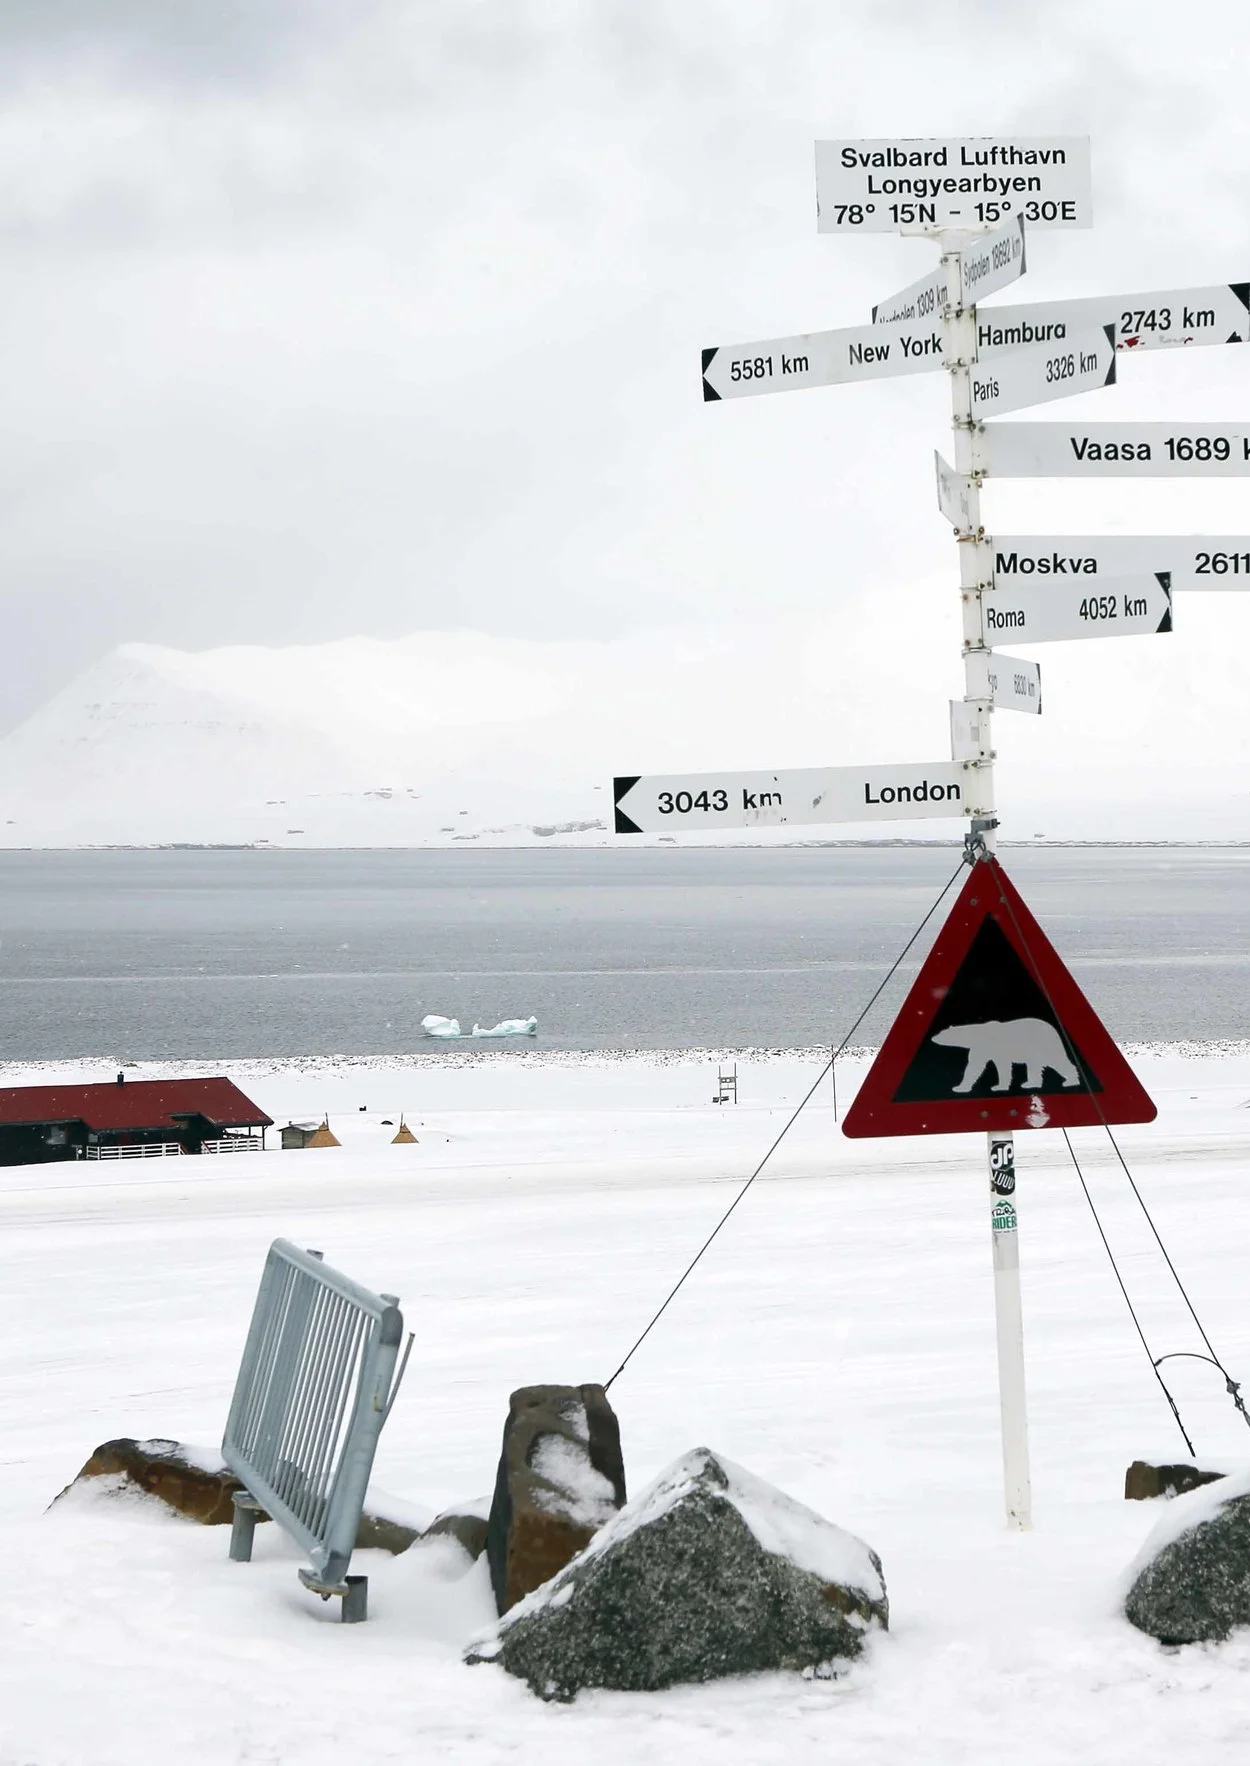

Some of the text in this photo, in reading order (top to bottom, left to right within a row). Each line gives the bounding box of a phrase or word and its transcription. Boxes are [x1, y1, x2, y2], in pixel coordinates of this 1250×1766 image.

[841, 145, 1066, 168] Svalbard Lufthavn
[868, 174, 1041, 197] Longyearbyen
[834, 204, 875, 225] 78°
[974, 202, 1011, 222] 15°
[964, 253, 990, 290] Sydpolen
[917, 288, 934, 318] 1309
[936, 284, 948, 307] km
[1121, 308, 1172, 333] 2743
[1183, 307, 1215, 328] km
[731, 333, 943, 382] 5581 km New York
[973, 352, 1097, 403] Paris 3326 km
[1070, 437, 1151, 461] Vaasa
[1164, 437, 1230, 461] 1689
[996, 552, 1098, 574] Moskva
[1195, 552, 1250, 574] 2611
[987, 595, 1147, 629] Roma 4052 km
[658, 780, 962, 814] 3043 km London
